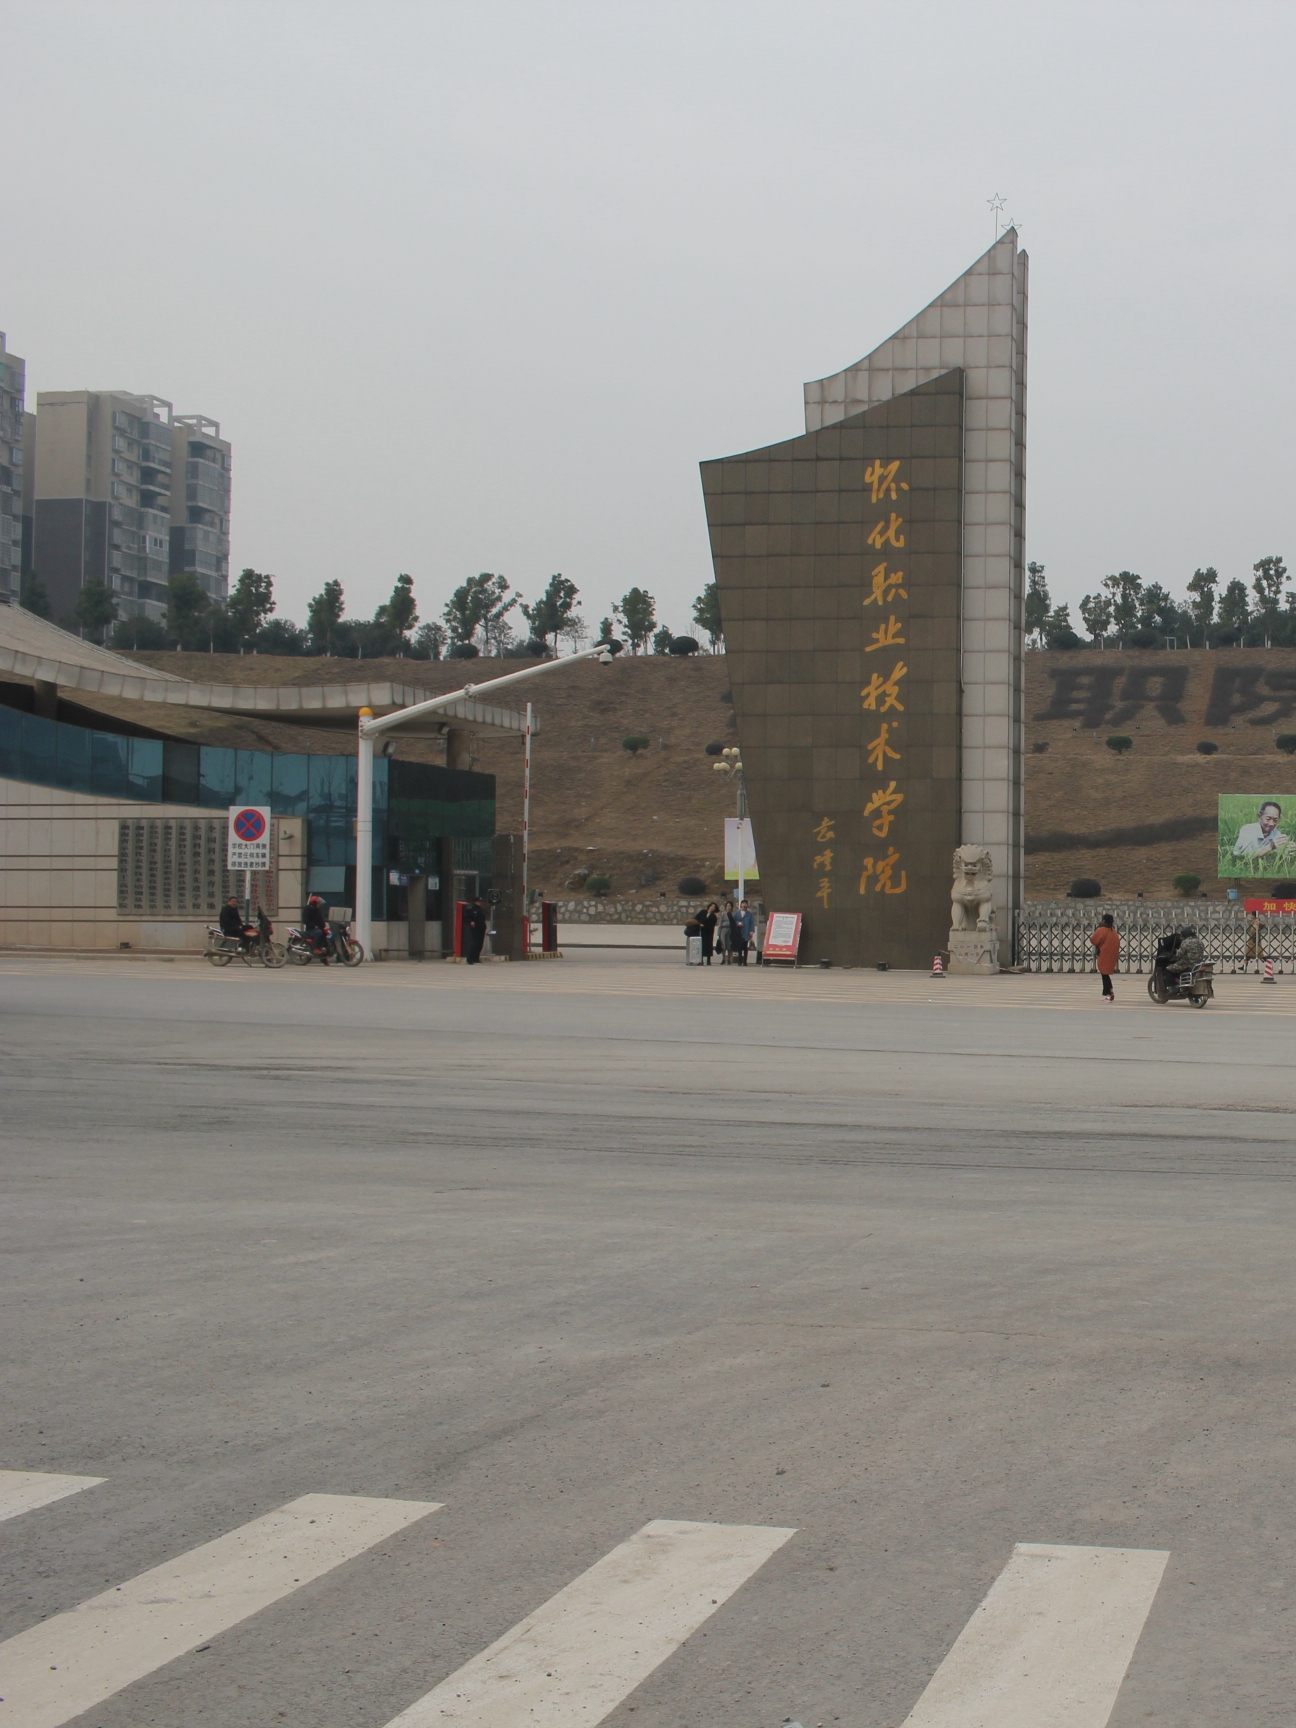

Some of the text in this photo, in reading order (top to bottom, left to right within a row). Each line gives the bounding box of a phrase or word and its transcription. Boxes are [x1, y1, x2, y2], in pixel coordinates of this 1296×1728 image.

[861, 458, 909, 894] 怀化职业技术学院
